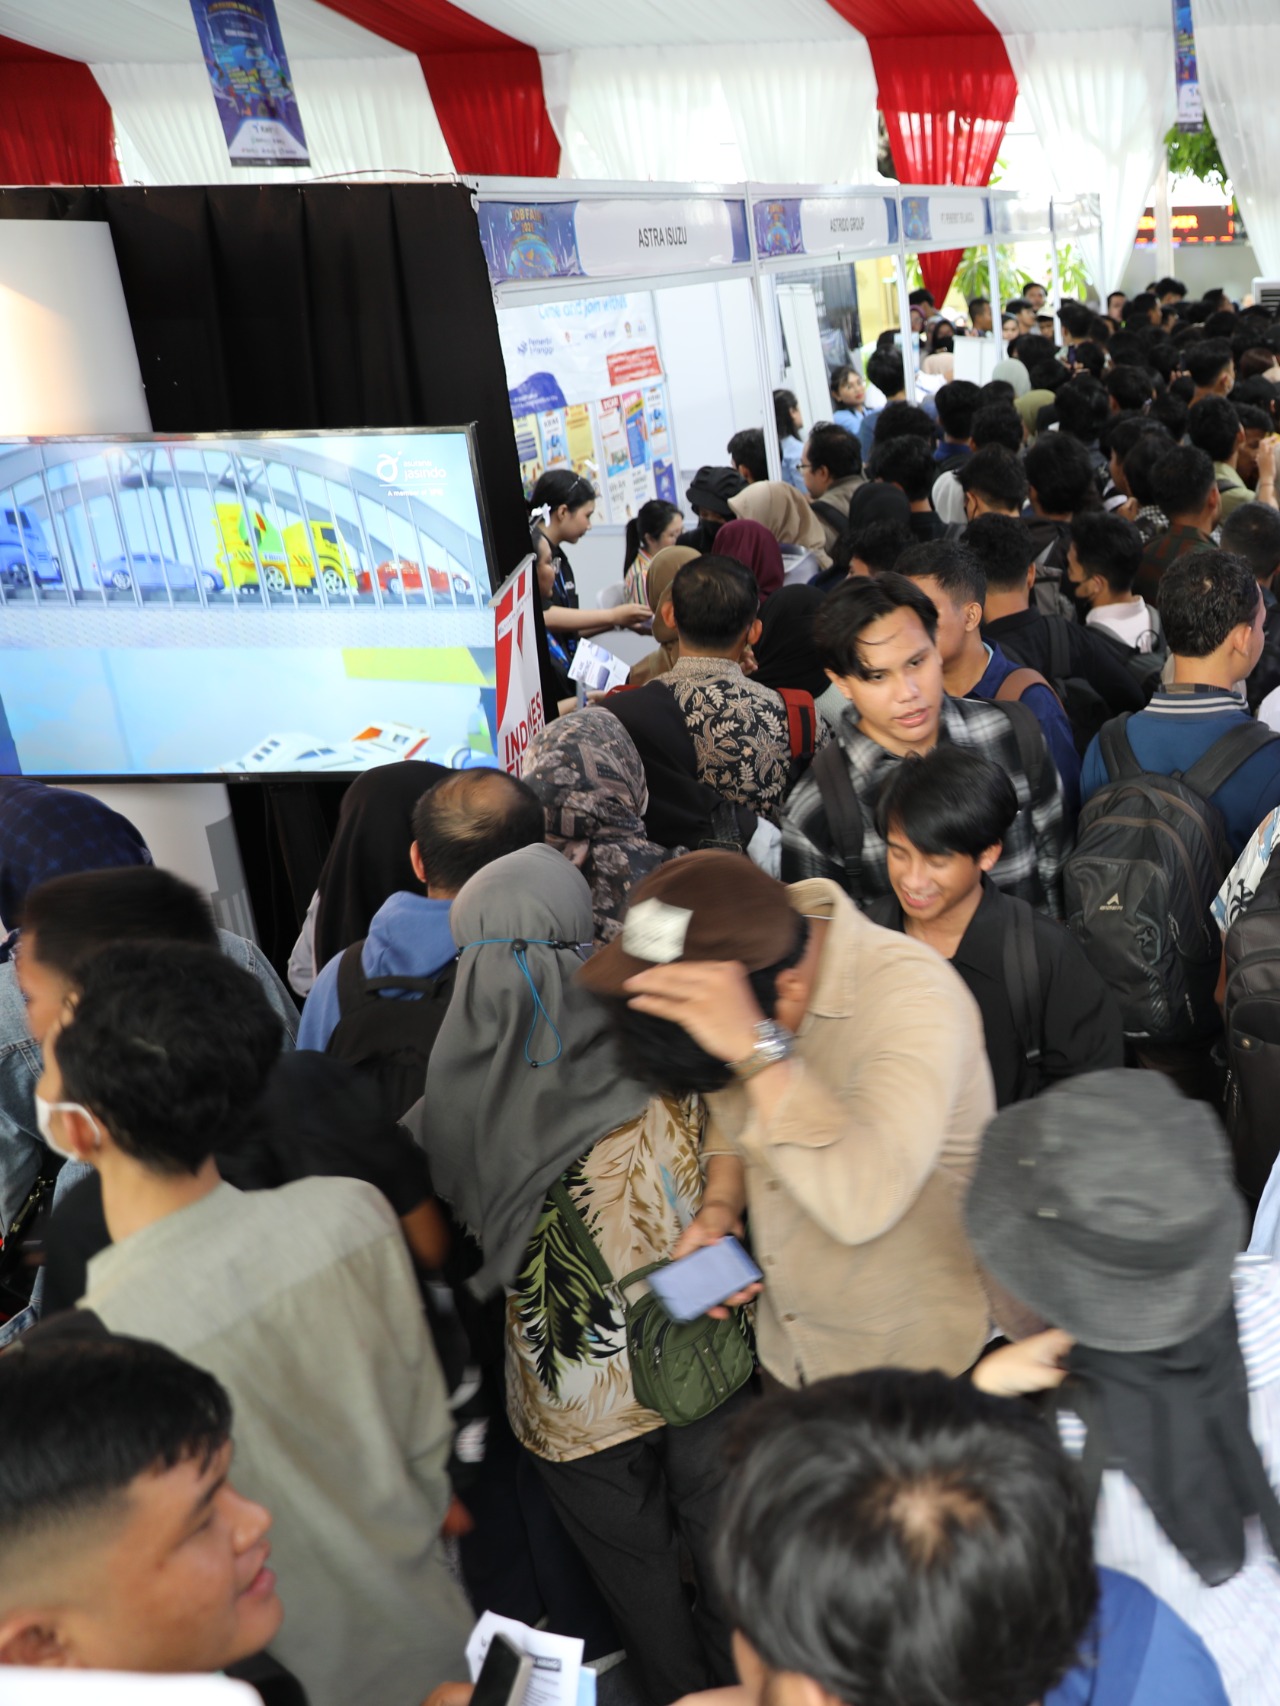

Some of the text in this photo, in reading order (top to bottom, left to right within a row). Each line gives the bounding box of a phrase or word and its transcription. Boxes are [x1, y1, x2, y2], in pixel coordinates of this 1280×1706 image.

[638, 226, 688, 248] ASTRA ISUZU
[404, 467, 447, 482] jasindo
